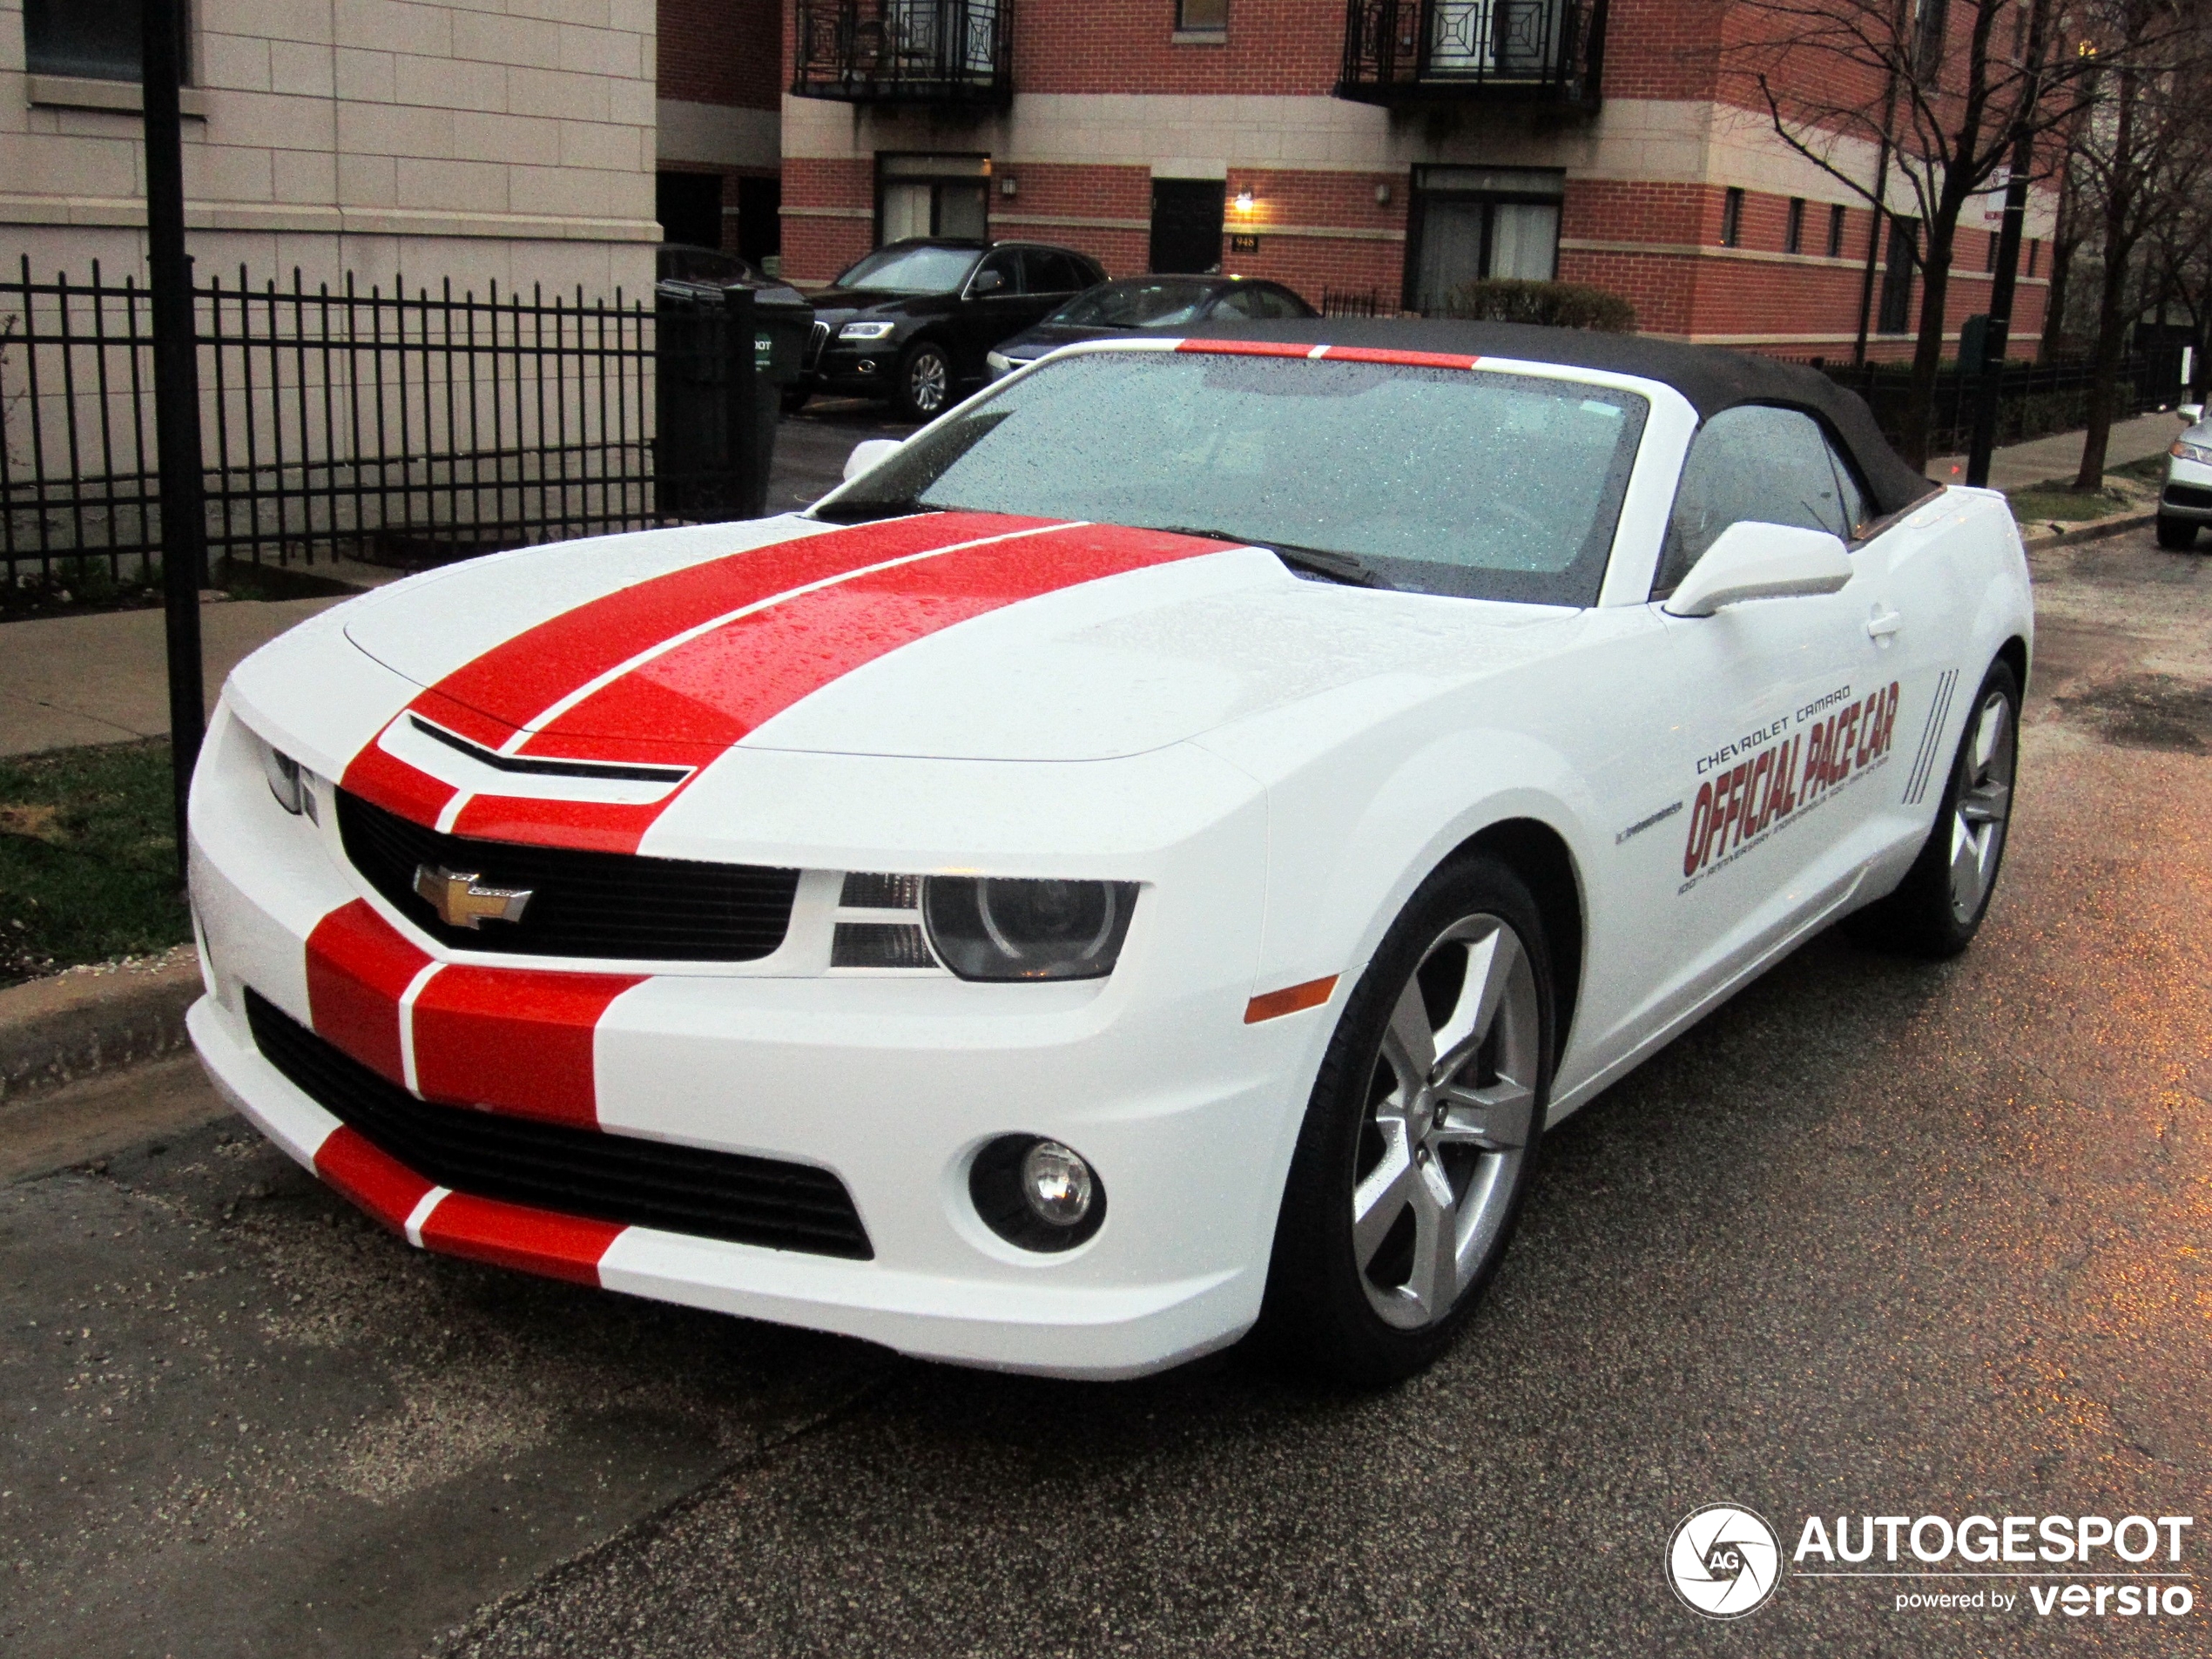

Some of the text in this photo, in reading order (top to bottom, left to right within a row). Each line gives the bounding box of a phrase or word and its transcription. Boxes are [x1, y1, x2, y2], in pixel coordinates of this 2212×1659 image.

[1237, 236, 1254, 246] 948
[1697, 685, 1851, 774] CHEVROLET CAMARO
[1683, 680, 1899, 878] OFFICIAL PACE CAR
